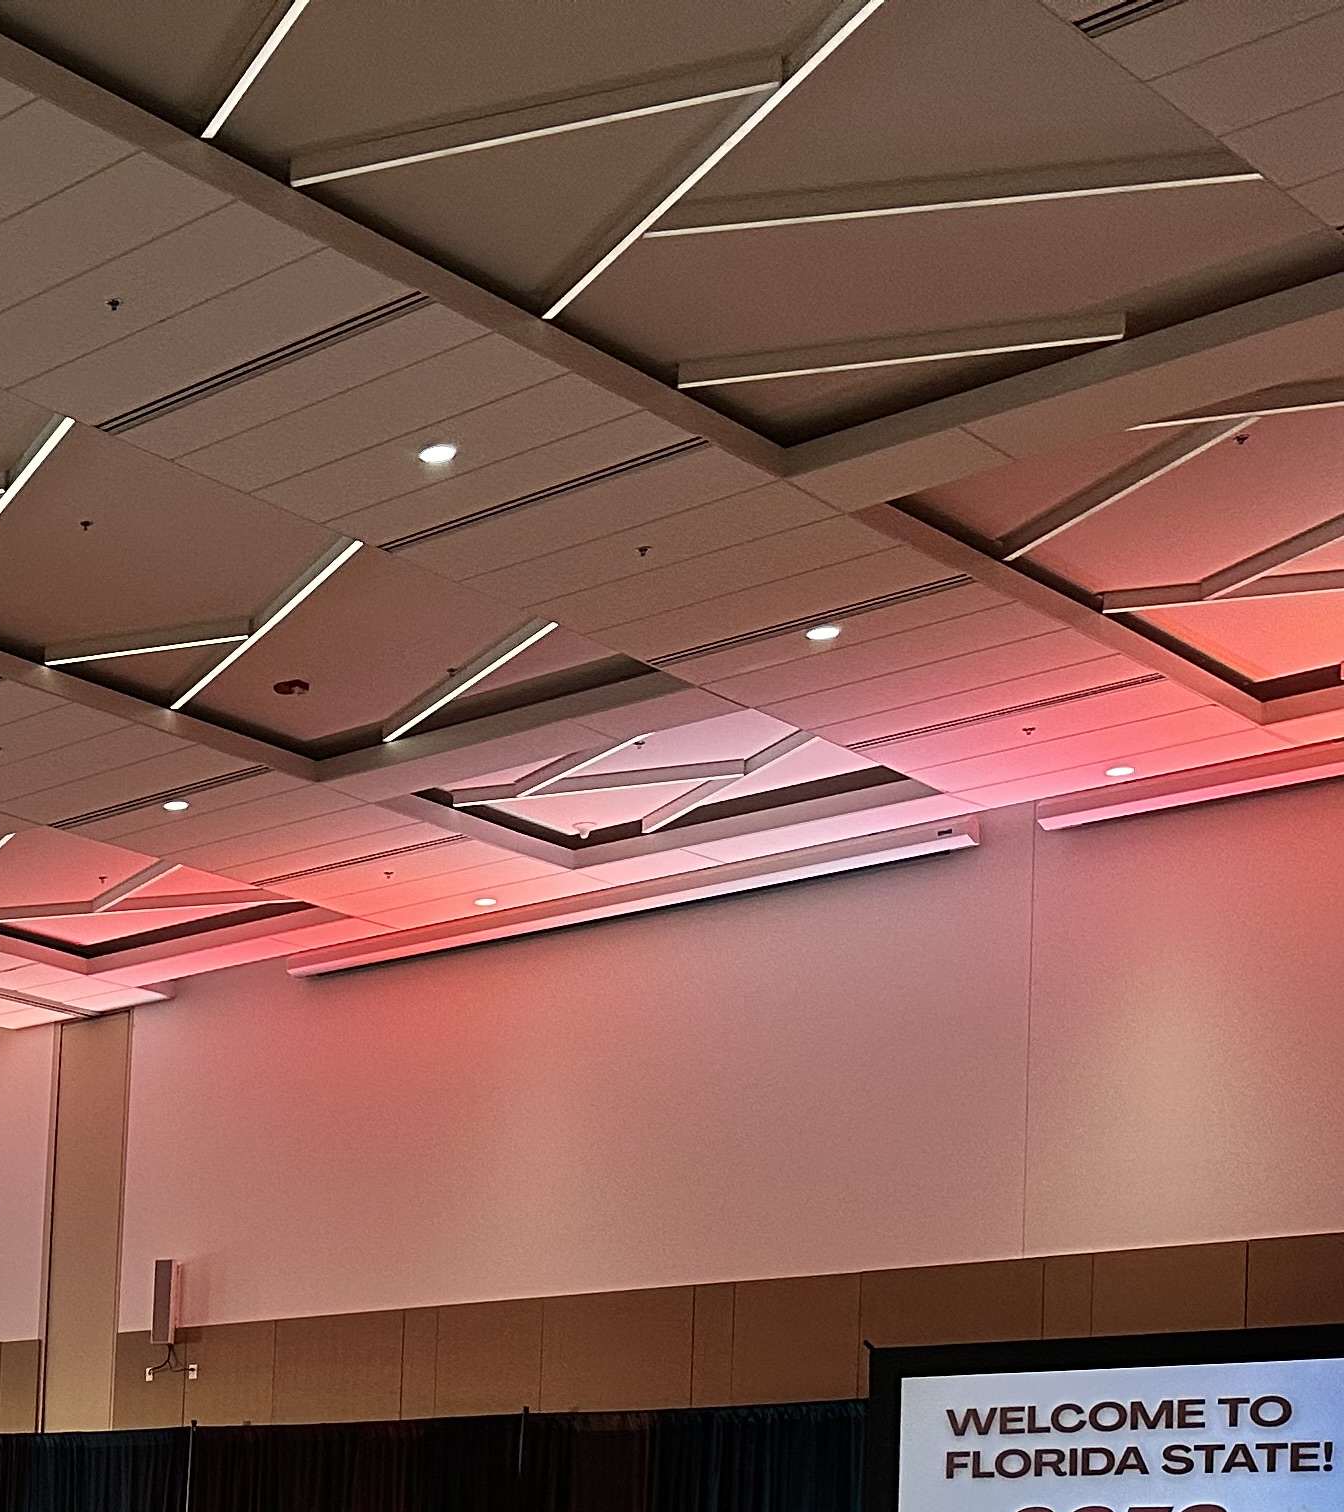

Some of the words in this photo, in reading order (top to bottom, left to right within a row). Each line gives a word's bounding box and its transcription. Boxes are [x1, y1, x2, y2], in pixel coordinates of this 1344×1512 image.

[946, 1398, 1206, 1437] WELCOME
[1217, 1395, 1292, 1428] TO
[945, 1445, 1150, 1479] FLORIDA
[1161, 1441, 1334, 1475] STATE!
